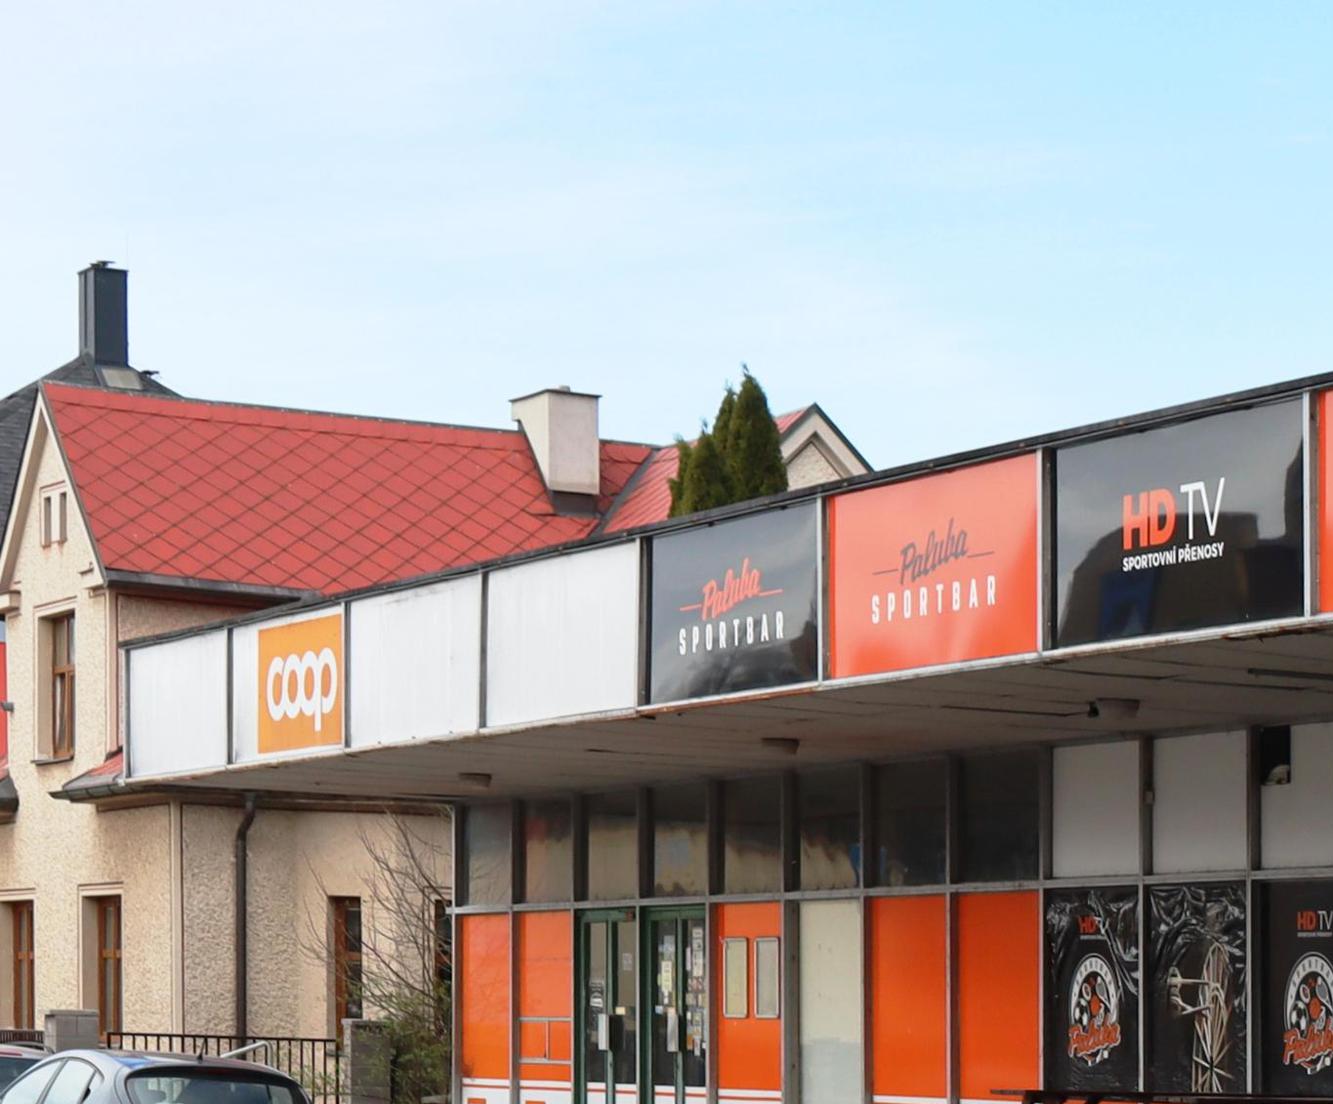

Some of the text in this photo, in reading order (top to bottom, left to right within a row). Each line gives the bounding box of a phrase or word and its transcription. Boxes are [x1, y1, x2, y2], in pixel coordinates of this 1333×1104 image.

[1123, 477, 1225, 550] HD TV
[901, 518, 969, 586] Paluba
[1122, 541, 1225, 572] SPORTOVNÍ PŘENOSY
[702, 558, 762, 620] Paluba
[871, 575, 997, 625] SPORTBAR
[679, 610, 784, 656] SPORTBAR
[267, 647, 338, 732] coop
[1297, 911, 1318, 930] HD
